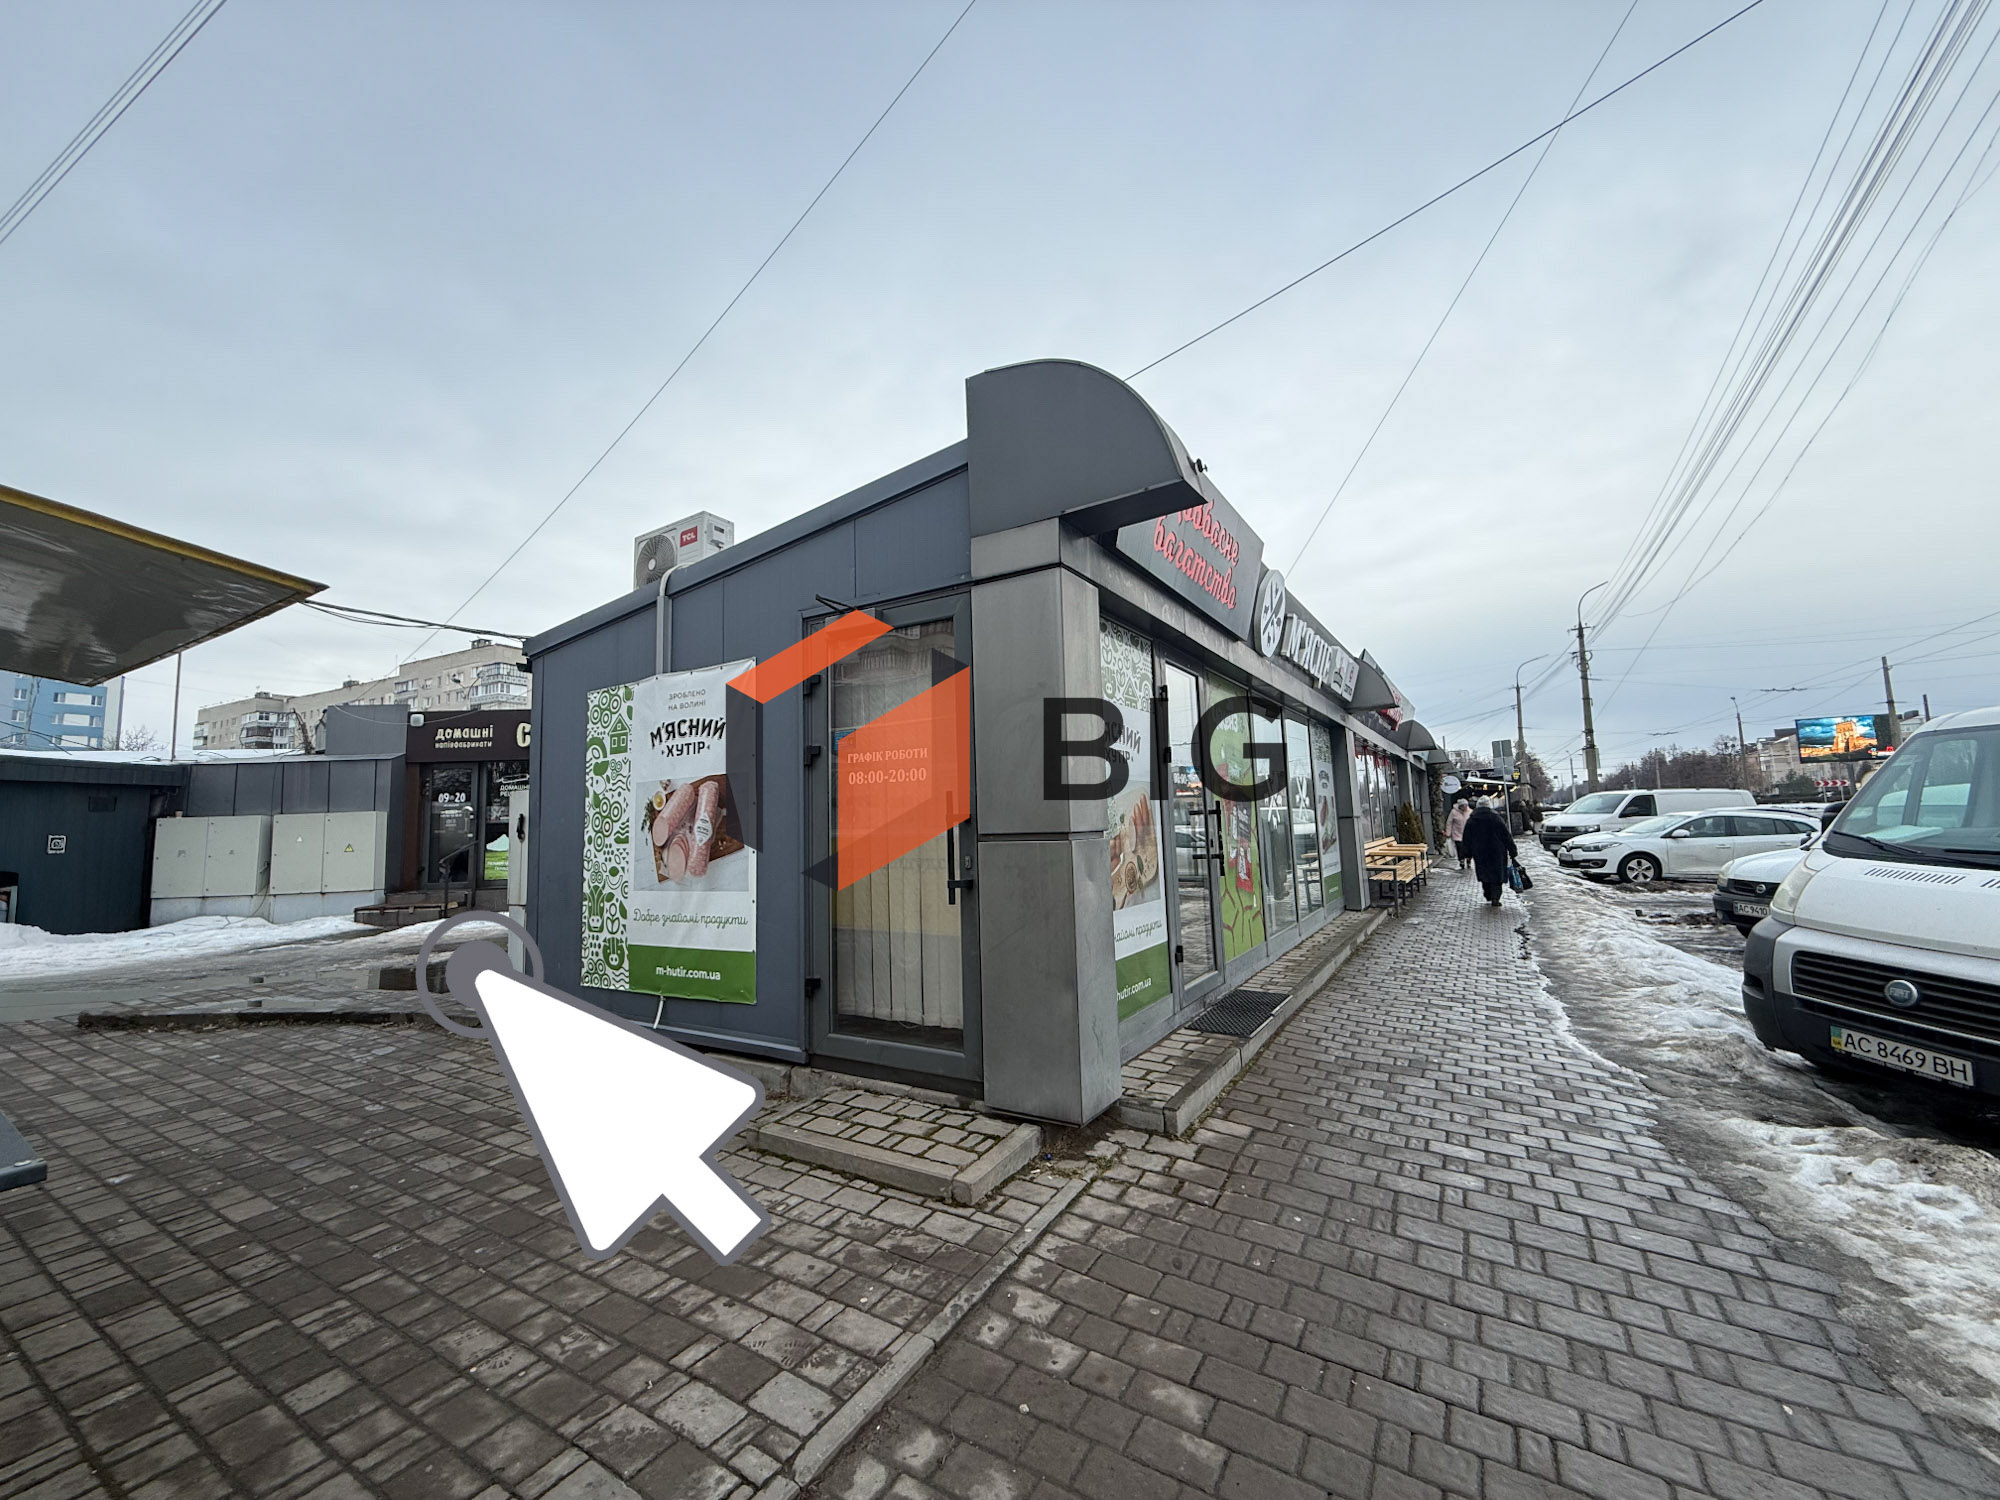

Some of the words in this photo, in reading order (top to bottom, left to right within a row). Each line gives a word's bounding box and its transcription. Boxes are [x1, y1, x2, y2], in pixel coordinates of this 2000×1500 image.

[682, 532, 696, 542] TCL
[1177, 499, 1239, 567] овбасне
[669, 688, 706, 700] ЗРОБЛЕНО
[668, 703, 678, 711] НА
[680, 700, 706, 710] ВОЛИНІ
[650, 717, 726, 750] М'ЯСНИЙ
[666, 741, 705, 758] ХУТІР
[847, 751, 883, 764] ГРАФІК
[885, 748, 928, 761] РОБОТИ
[848, 767, 927, 785] 08:00-20:00
[1739, 903, 1749, 913] AC
[633, 908, 660, 926] Добре
[662, 913, 699, 927] знайомі
[700, 915, 748, 929] продукти
[656, 965, 721, 981] m-hutir.com.ua
[1844, 1033, 1871, 1053] AC
[1877, 1041, 1926, 1068] 8469
[1933, 1055, 1969, 1082] BH
